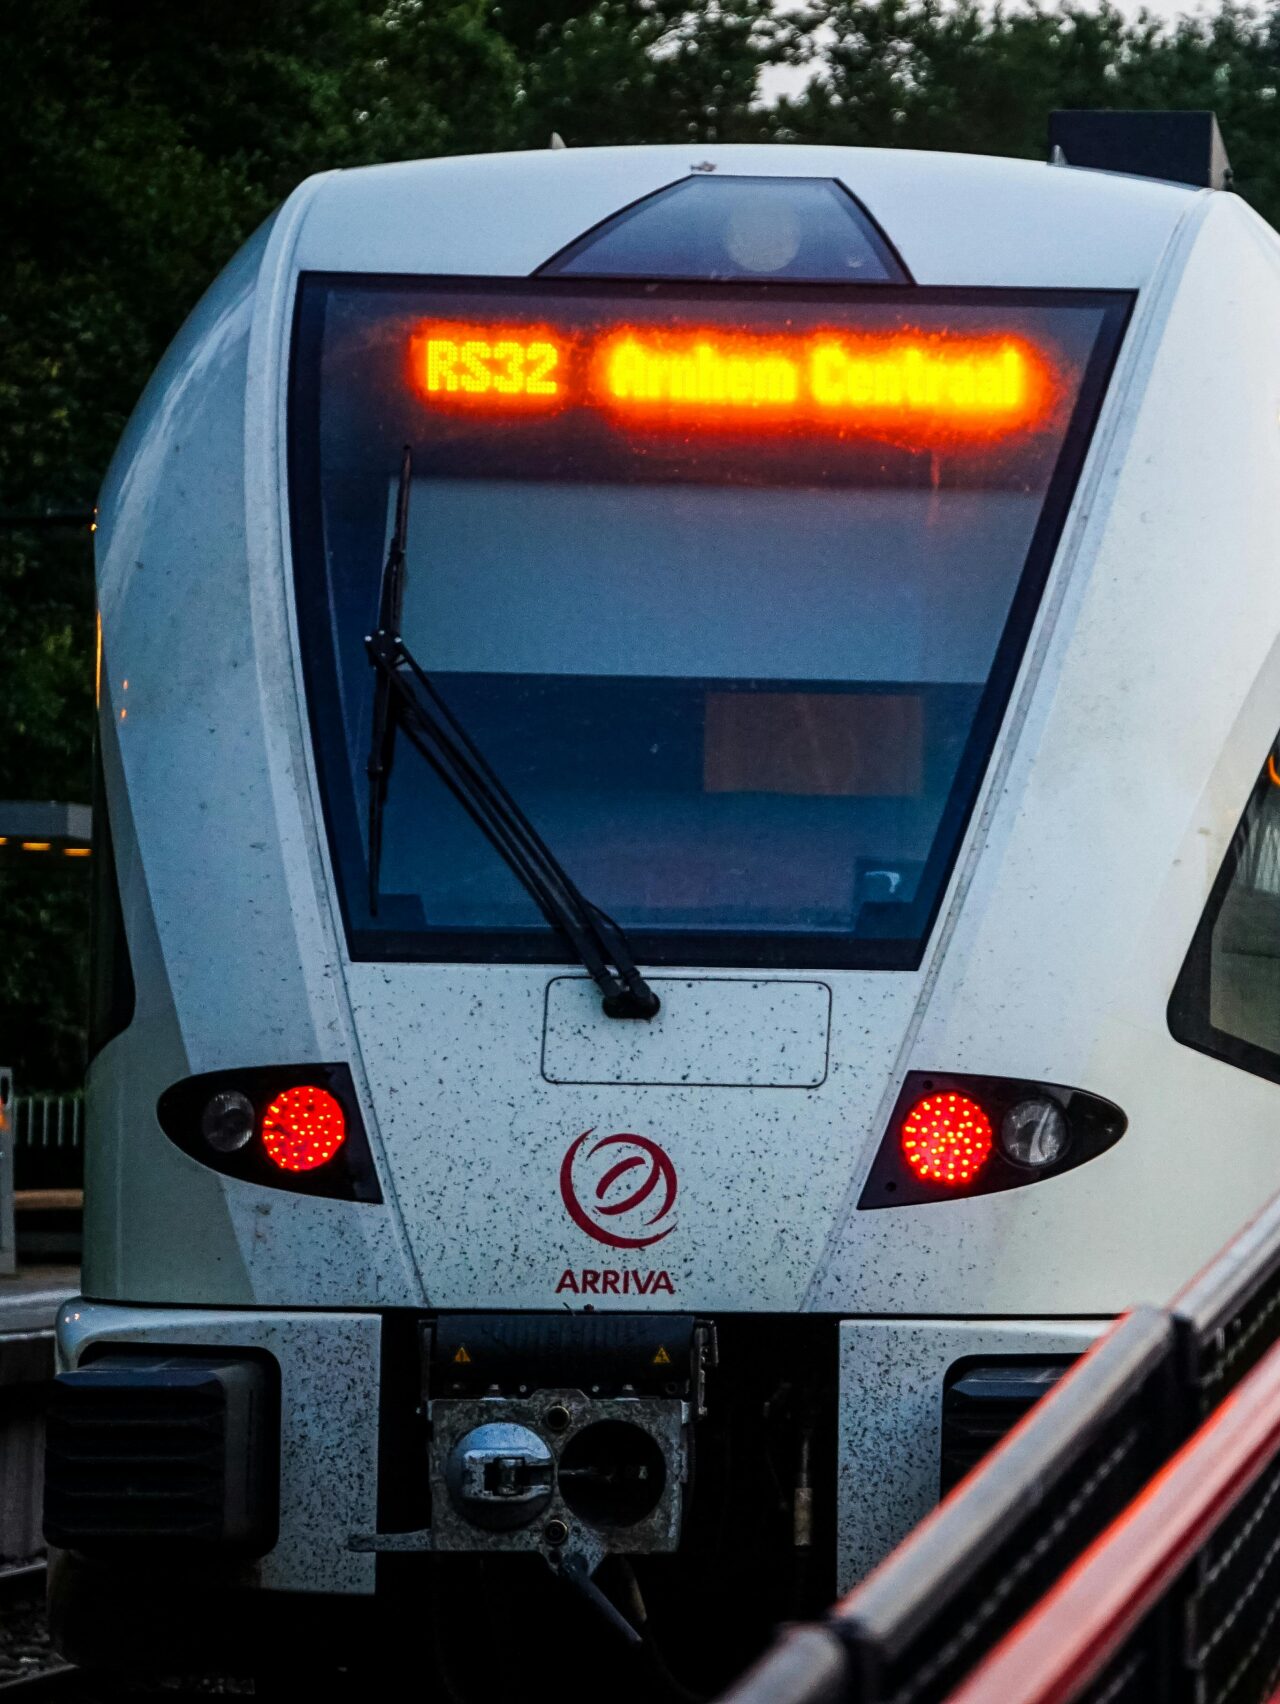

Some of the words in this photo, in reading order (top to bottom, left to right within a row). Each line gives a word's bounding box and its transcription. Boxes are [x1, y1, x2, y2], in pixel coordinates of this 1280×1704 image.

[427, 340, 557, 393] RS32
[610, 340, 797, 399] Arnhem
[811, 345, 1022, 405] Centraal
[555, 1269, 674, 1295] ARRIVA
